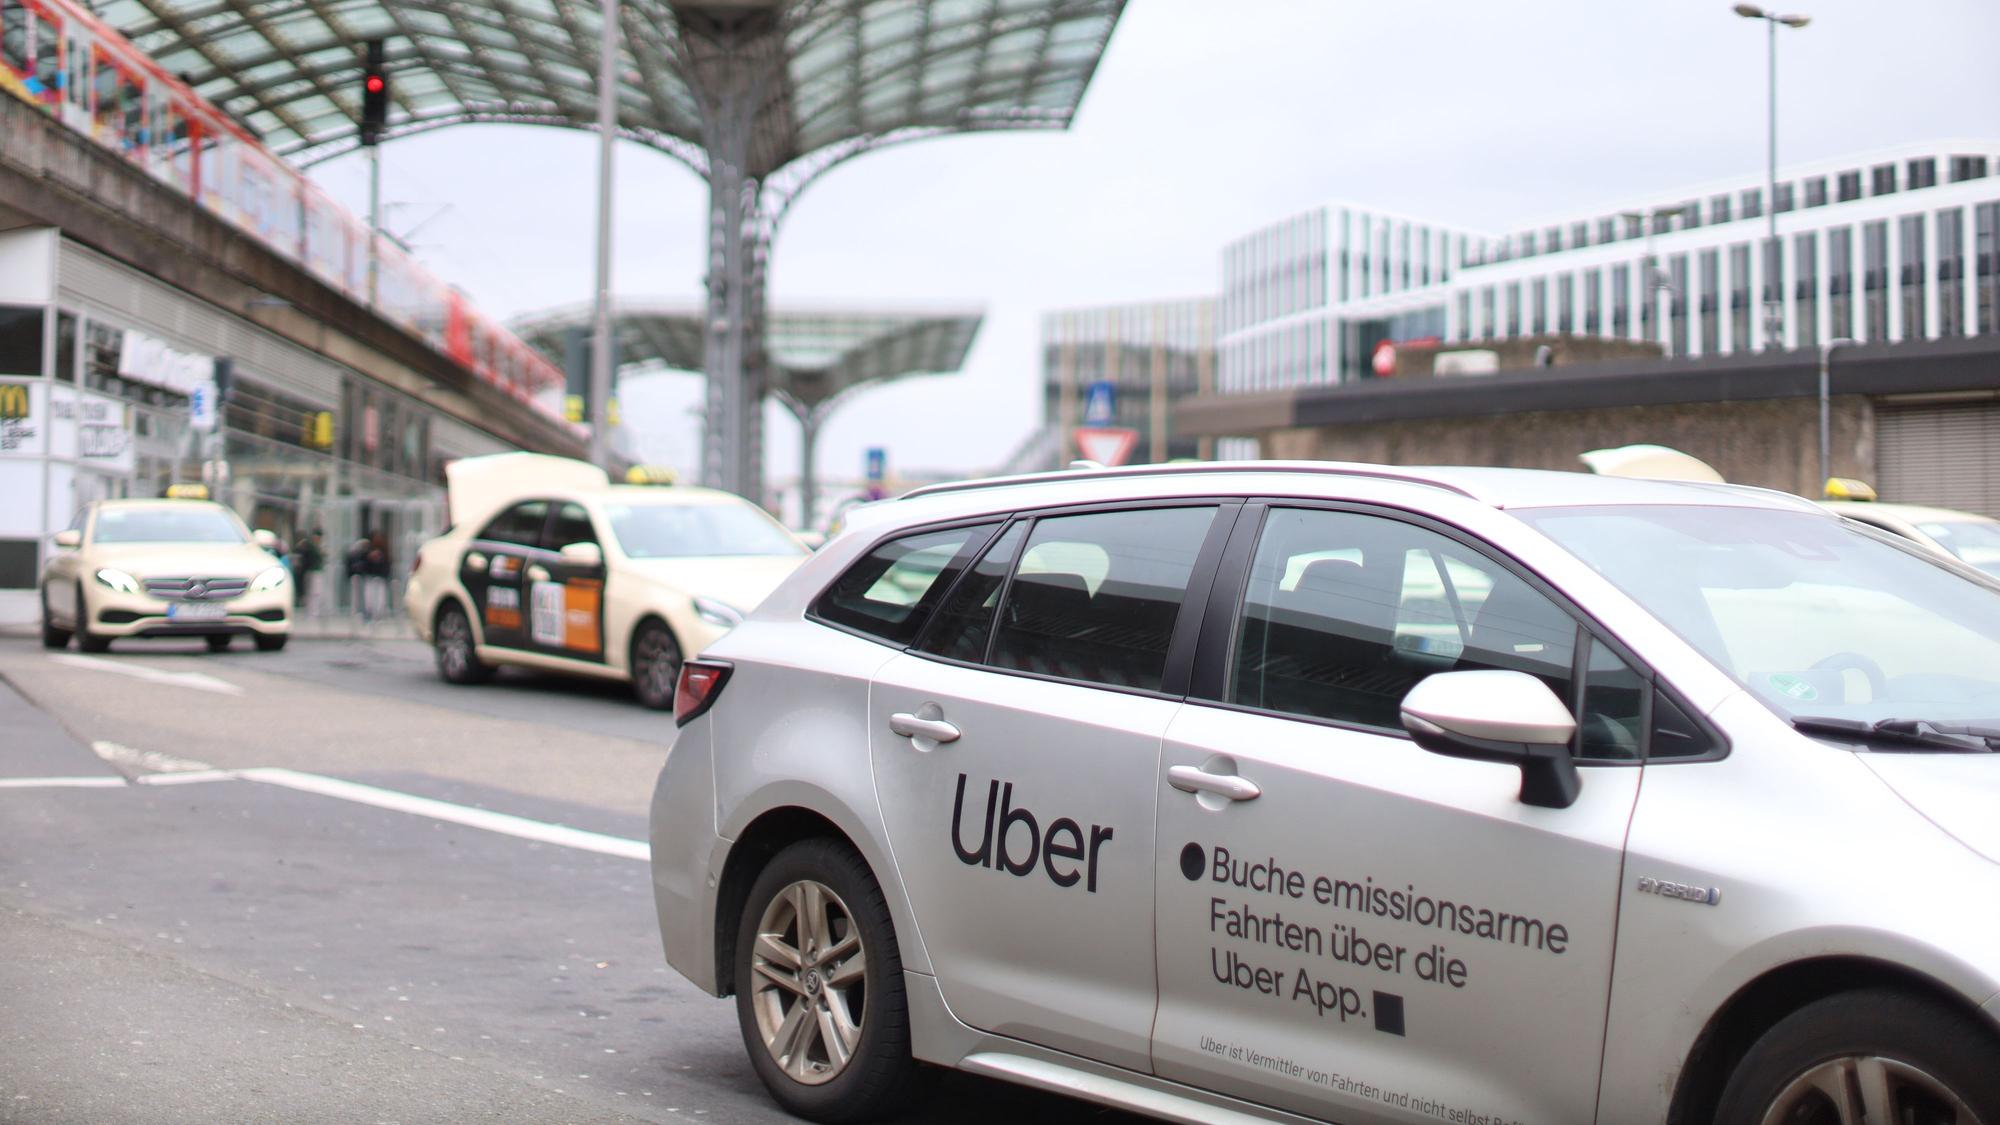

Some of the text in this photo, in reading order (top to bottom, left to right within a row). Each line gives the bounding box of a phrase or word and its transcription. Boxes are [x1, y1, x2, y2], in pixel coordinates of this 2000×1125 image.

[951, 773, 1113, 893] Uber
[1210, 897, 1468, 988] Fahrten über die
[1212, 846, 1568, 954] Buche emissionsarme
[1211, 947, 1367, 1021] Uber App.
[1200, 1035, 1227, 1055] Uber
[1229, 1043, 1244, 1060] ist
[1246, 1047, 1304, 1077] Vermittler
[1307, 1068, 1328, 1085] von
[1331, 1073, 1379, 1099] Fahrten
[1383, 1092, 1409, 1107] und
[1411, 1097, 1446, 1118] nicht
[1449, 1108, 1490, 1125] selbst
